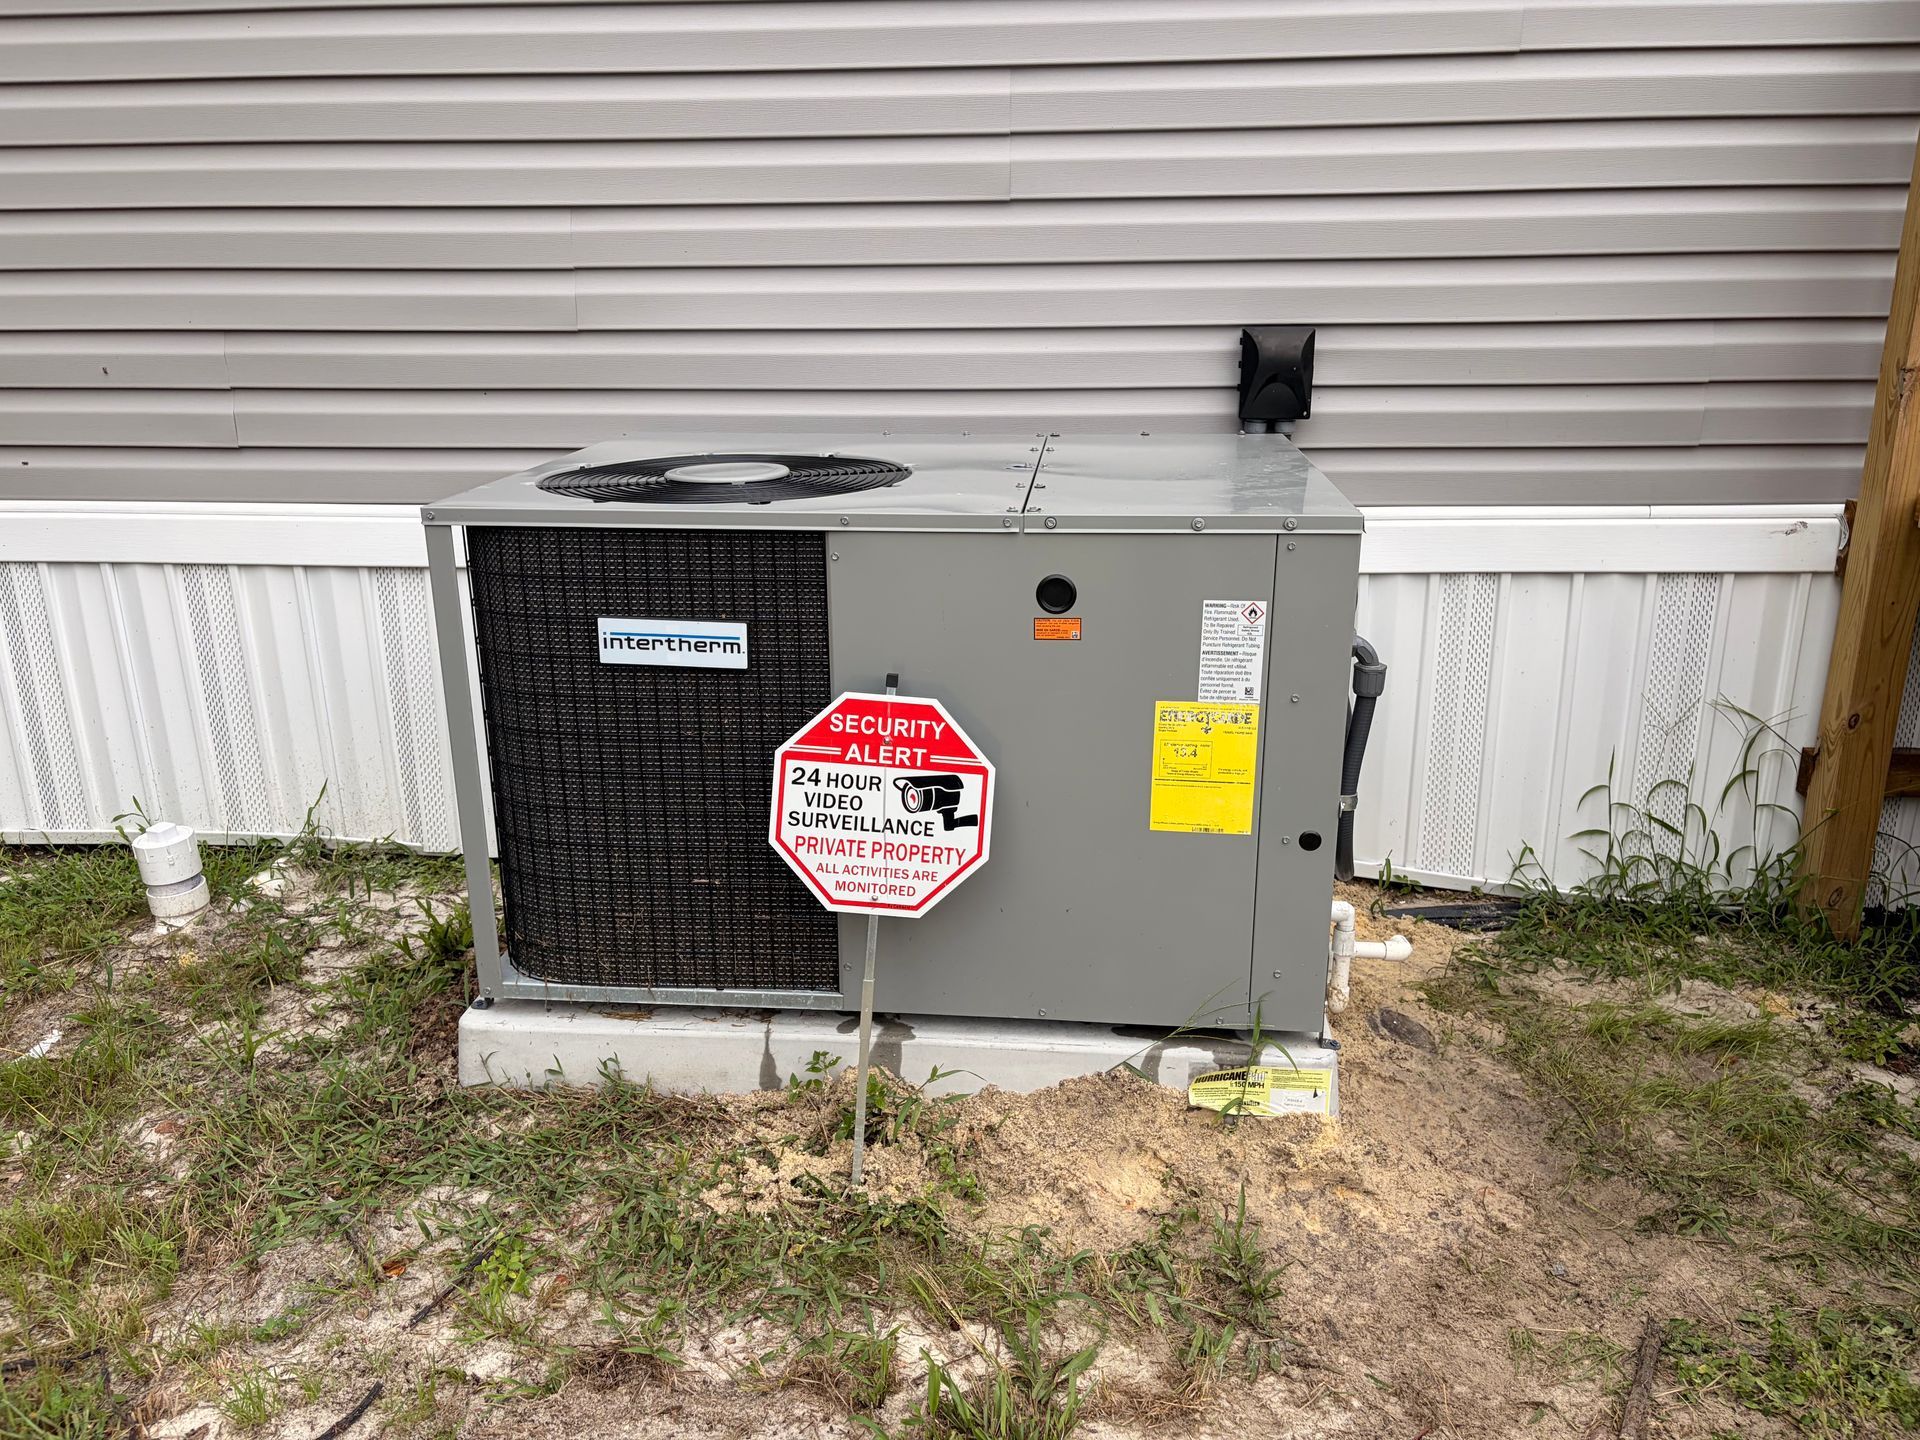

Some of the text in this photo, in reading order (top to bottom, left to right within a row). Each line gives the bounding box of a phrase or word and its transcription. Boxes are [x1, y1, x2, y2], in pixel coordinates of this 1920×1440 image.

[829, 713, 946, 740] SECURITY
[845, 744, 927, 767] ALERT
[791, 767, 882, 792] 24 HOUR
[804, 792, 863, 811] VIDEO
[788, 811, 935, 837] SURVEILLANCE
[794, 835, 966, 866] PRIVATE PROPERTY
[816, 862, 938, 882] ALL ACTIVITIES ARE
[835, 881, 916, 897] MONITORED
